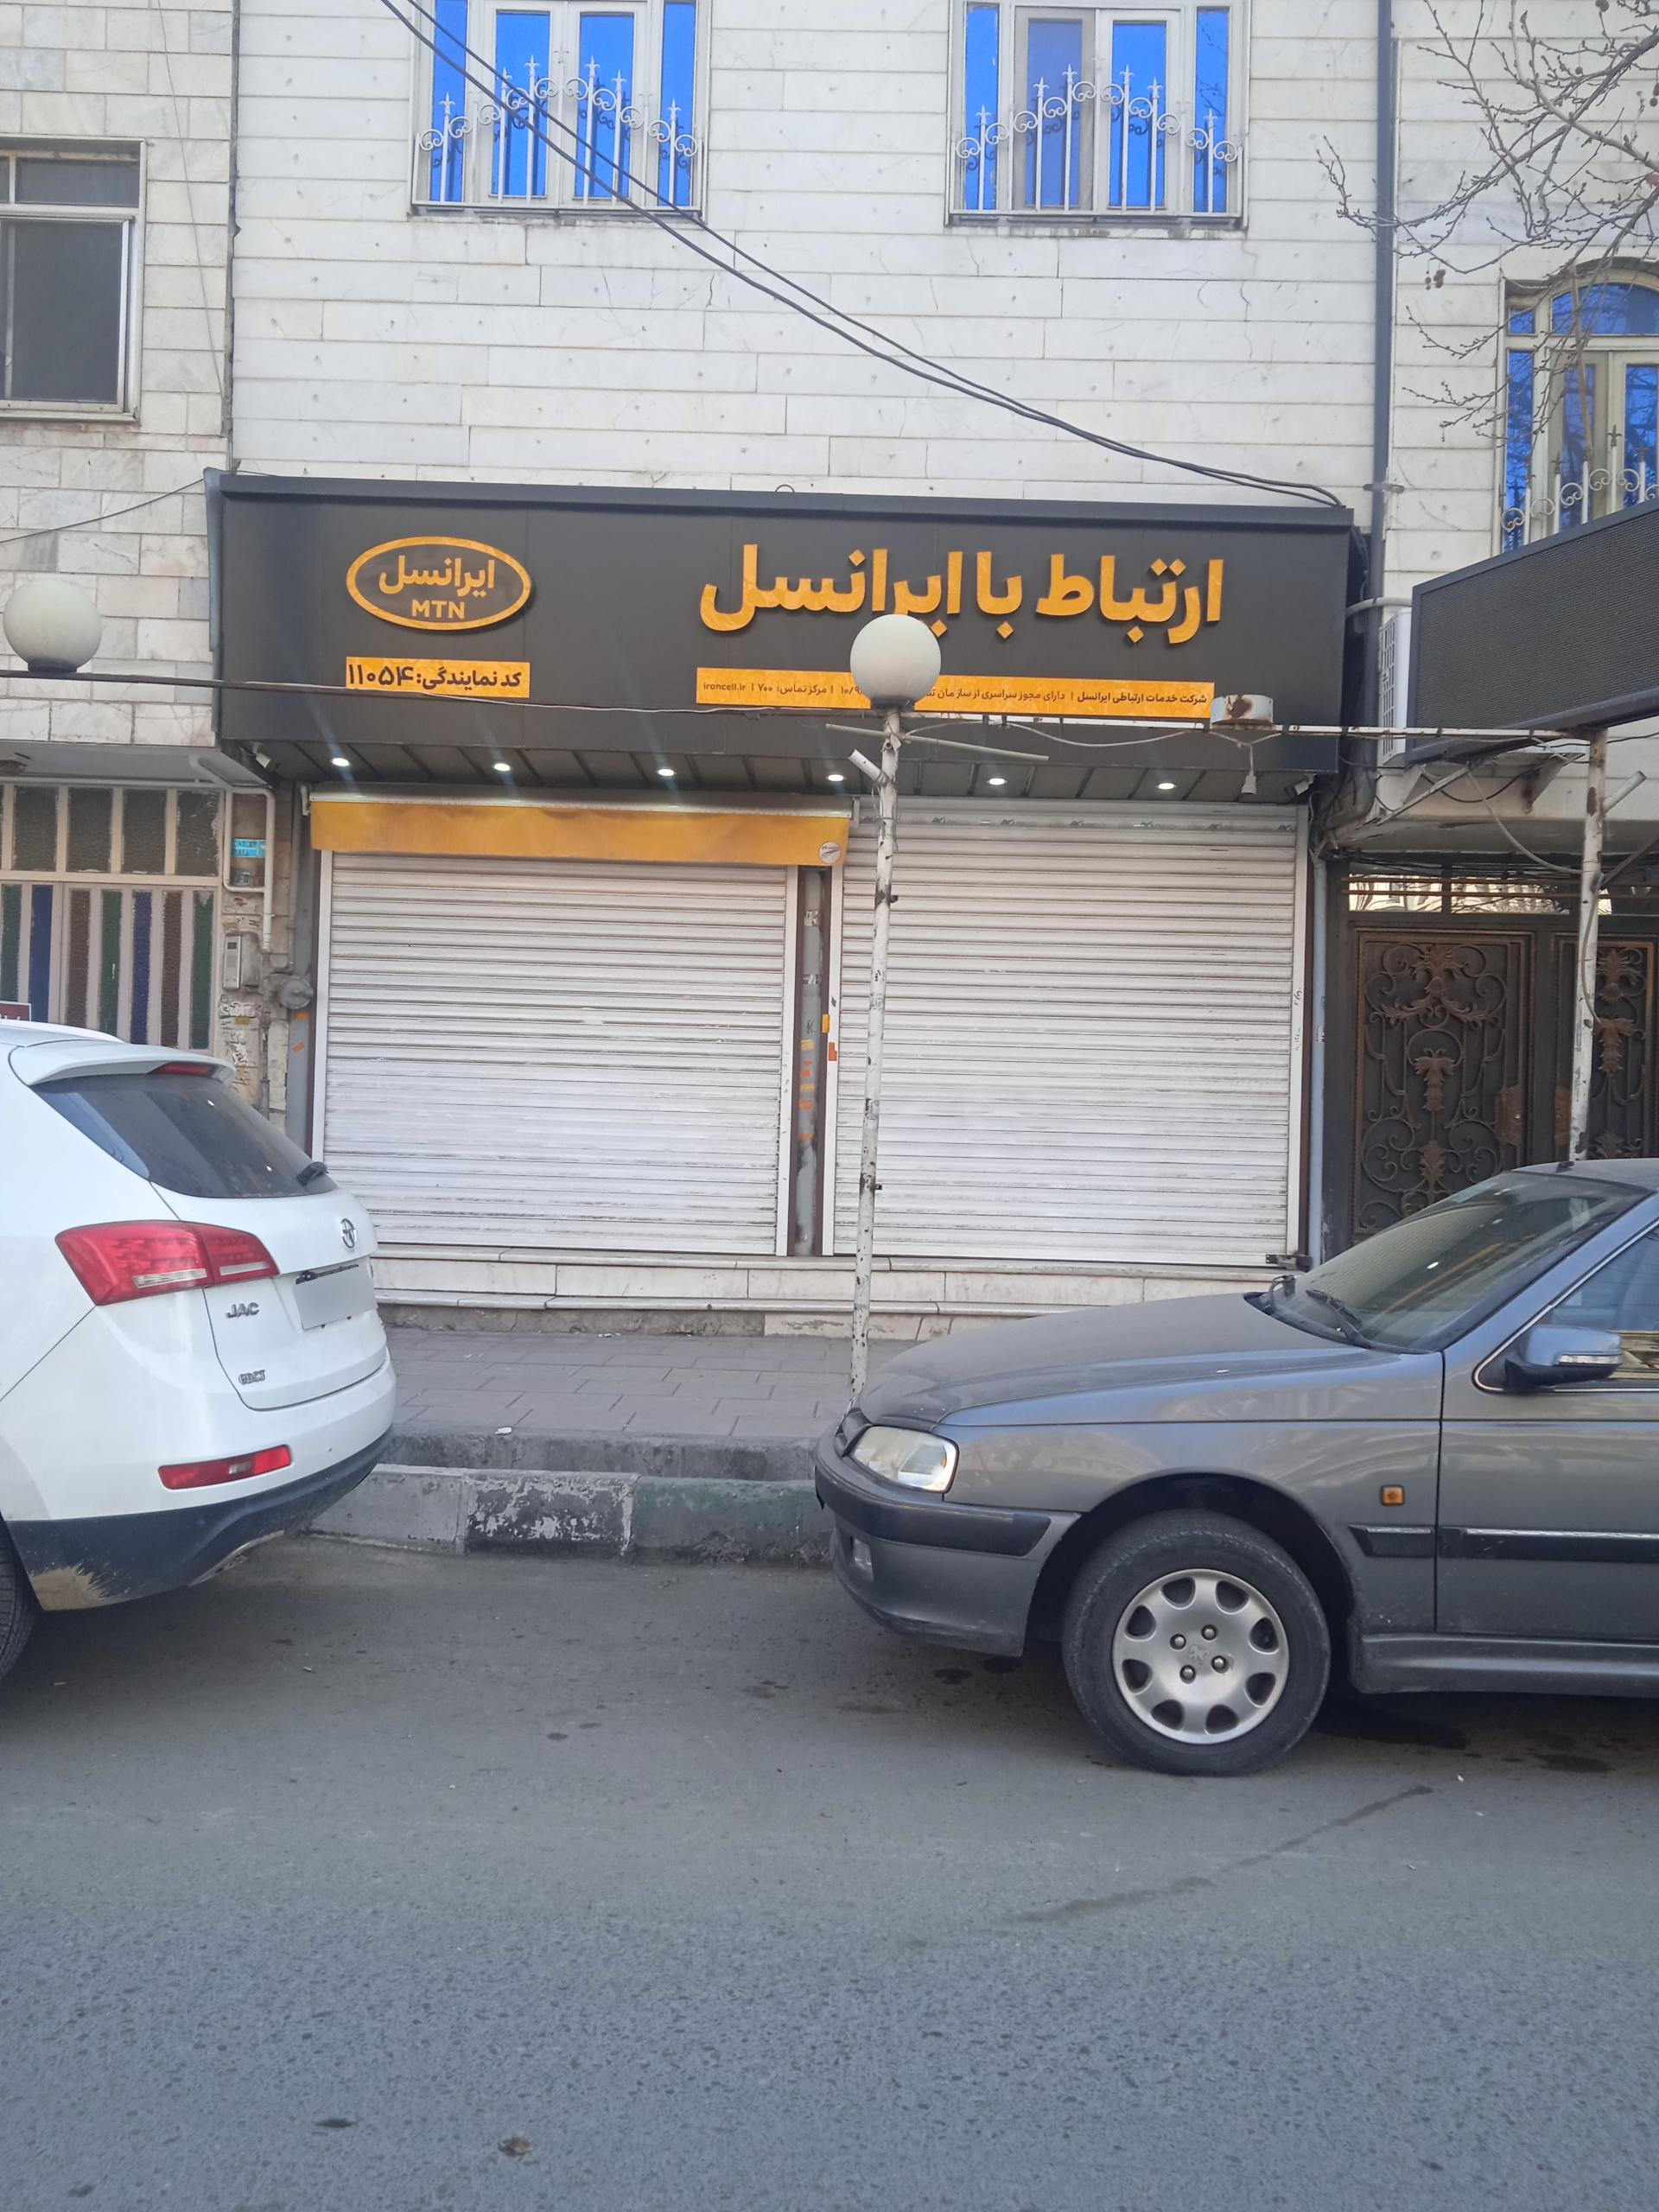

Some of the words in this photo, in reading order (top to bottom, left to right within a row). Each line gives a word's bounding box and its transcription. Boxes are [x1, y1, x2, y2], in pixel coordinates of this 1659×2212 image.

[379, 556, 495, 598] ایرانسل
[699, 543, 963, 638] ایرانسل
[976, 551, 1022, 639] با
[1036, 554, 1224, 644] ارتباط
[411, 599, 465, 620] MTN
[499, 671, 522, 687] کد
[808, 684, 827, 696] مرکز
[972, 689, 980, 699] از
[982, 690, 1017, 700] سراسری
[1043, 690, 1065, 702] دارای
[1019, 692, 1040, 702] مجوز
[1077, 692, 1110, 704] ایرانسل
[1112, 693, 1143, 704] ارتباطی
[1146, 692, 1177, 702] خدمات
[1179, 694, 1207, 705] شرکت
[226, 1302, 259, 1318] JAC
